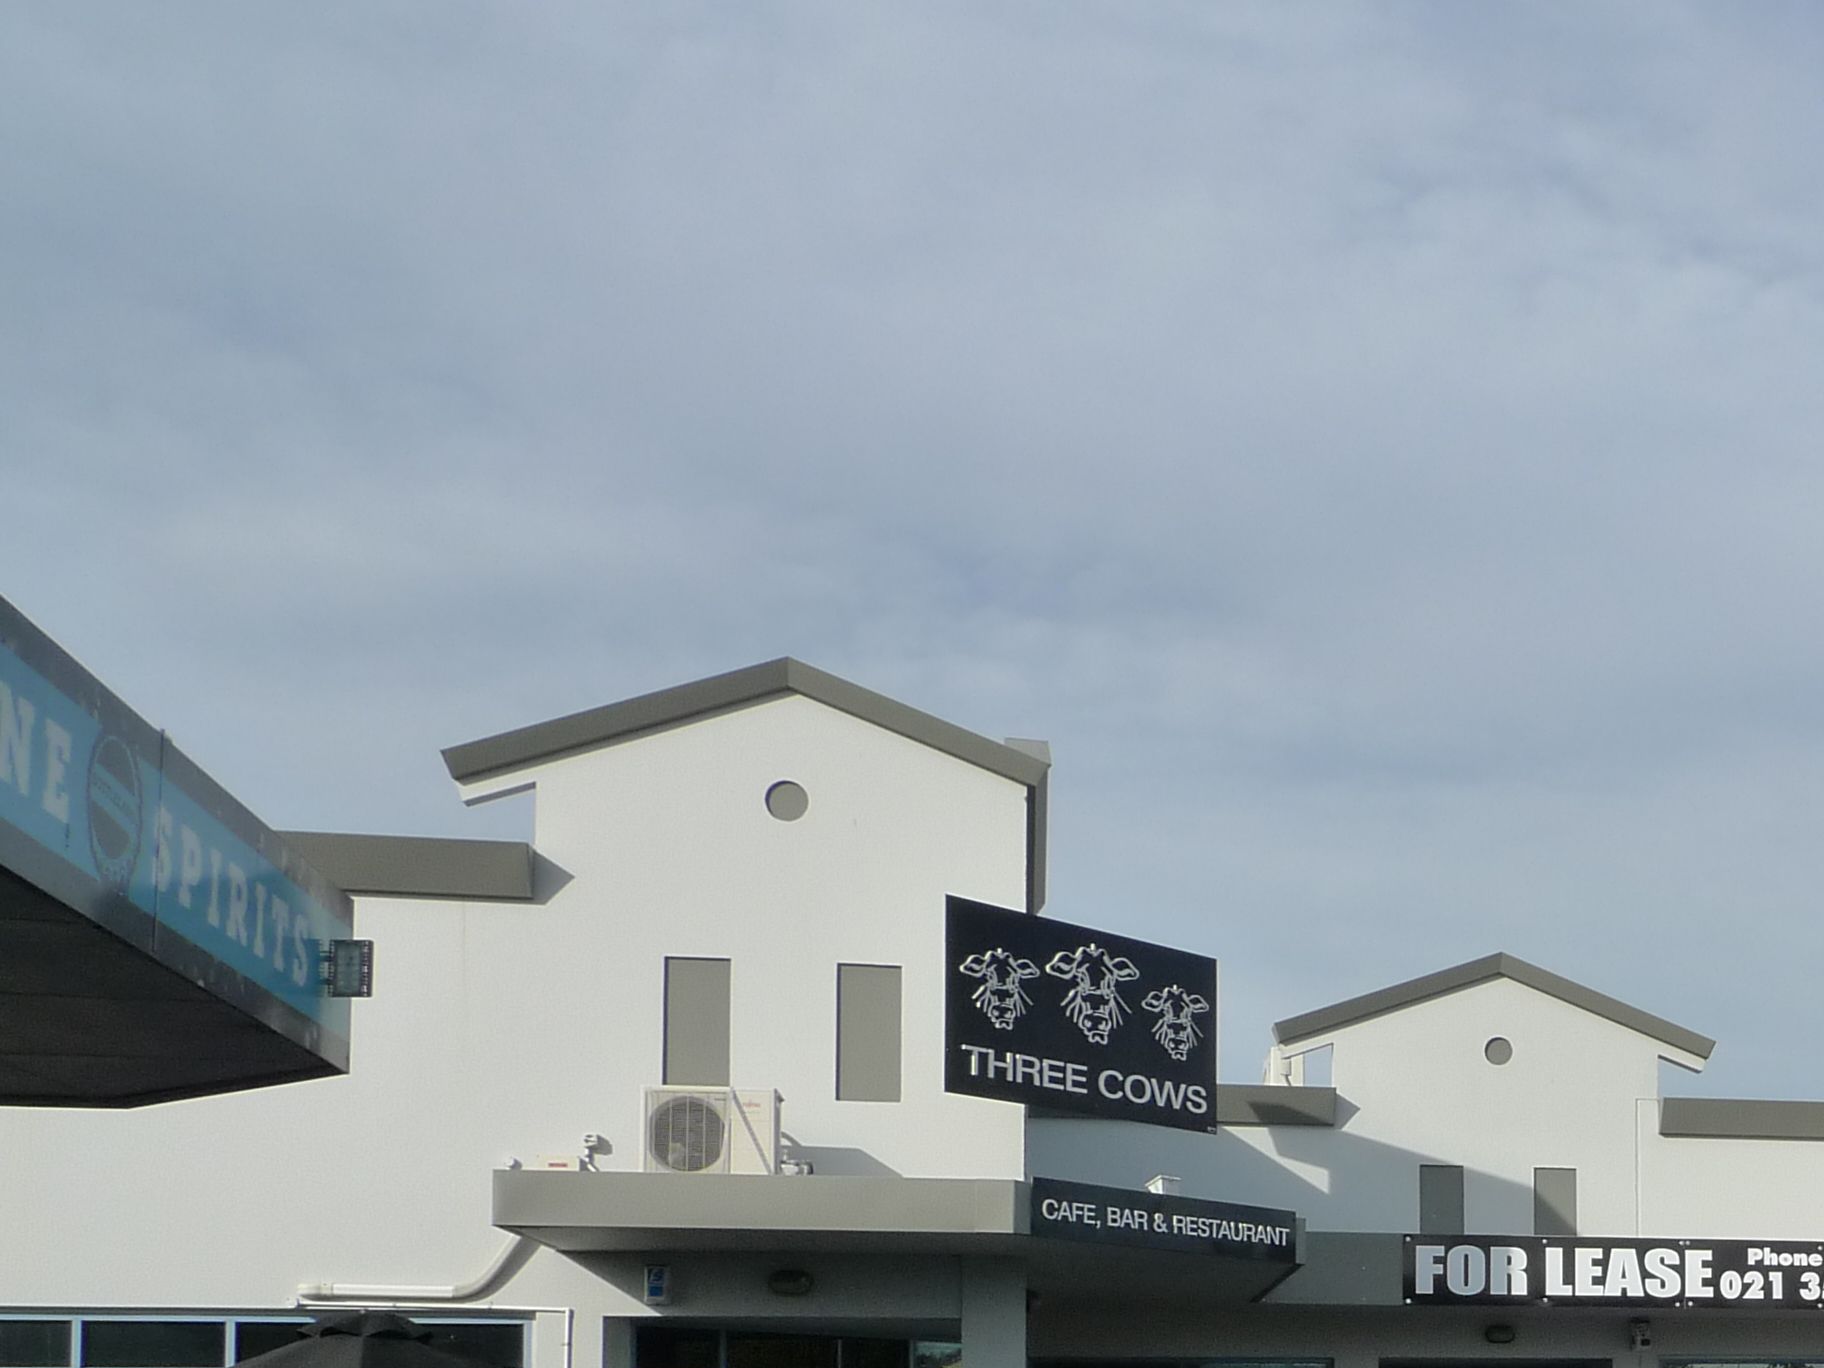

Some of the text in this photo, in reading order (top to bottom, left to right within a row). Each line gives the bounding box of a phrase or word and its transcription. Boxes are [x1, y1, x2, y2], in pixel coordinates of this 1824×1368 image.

[152, 805, 310, 988] SPIRITS
[961, 1043, 1208, 1115] THREE COWS
[1041, 1198, 1290, 1247] CAFE, BAR & RESTAURANT
[1415, 1244, 1714, 1299] FOR LEASE
[1747, 1248, 1823, 1268] Phone
[1719, 1270, 1784, 1300] 021
